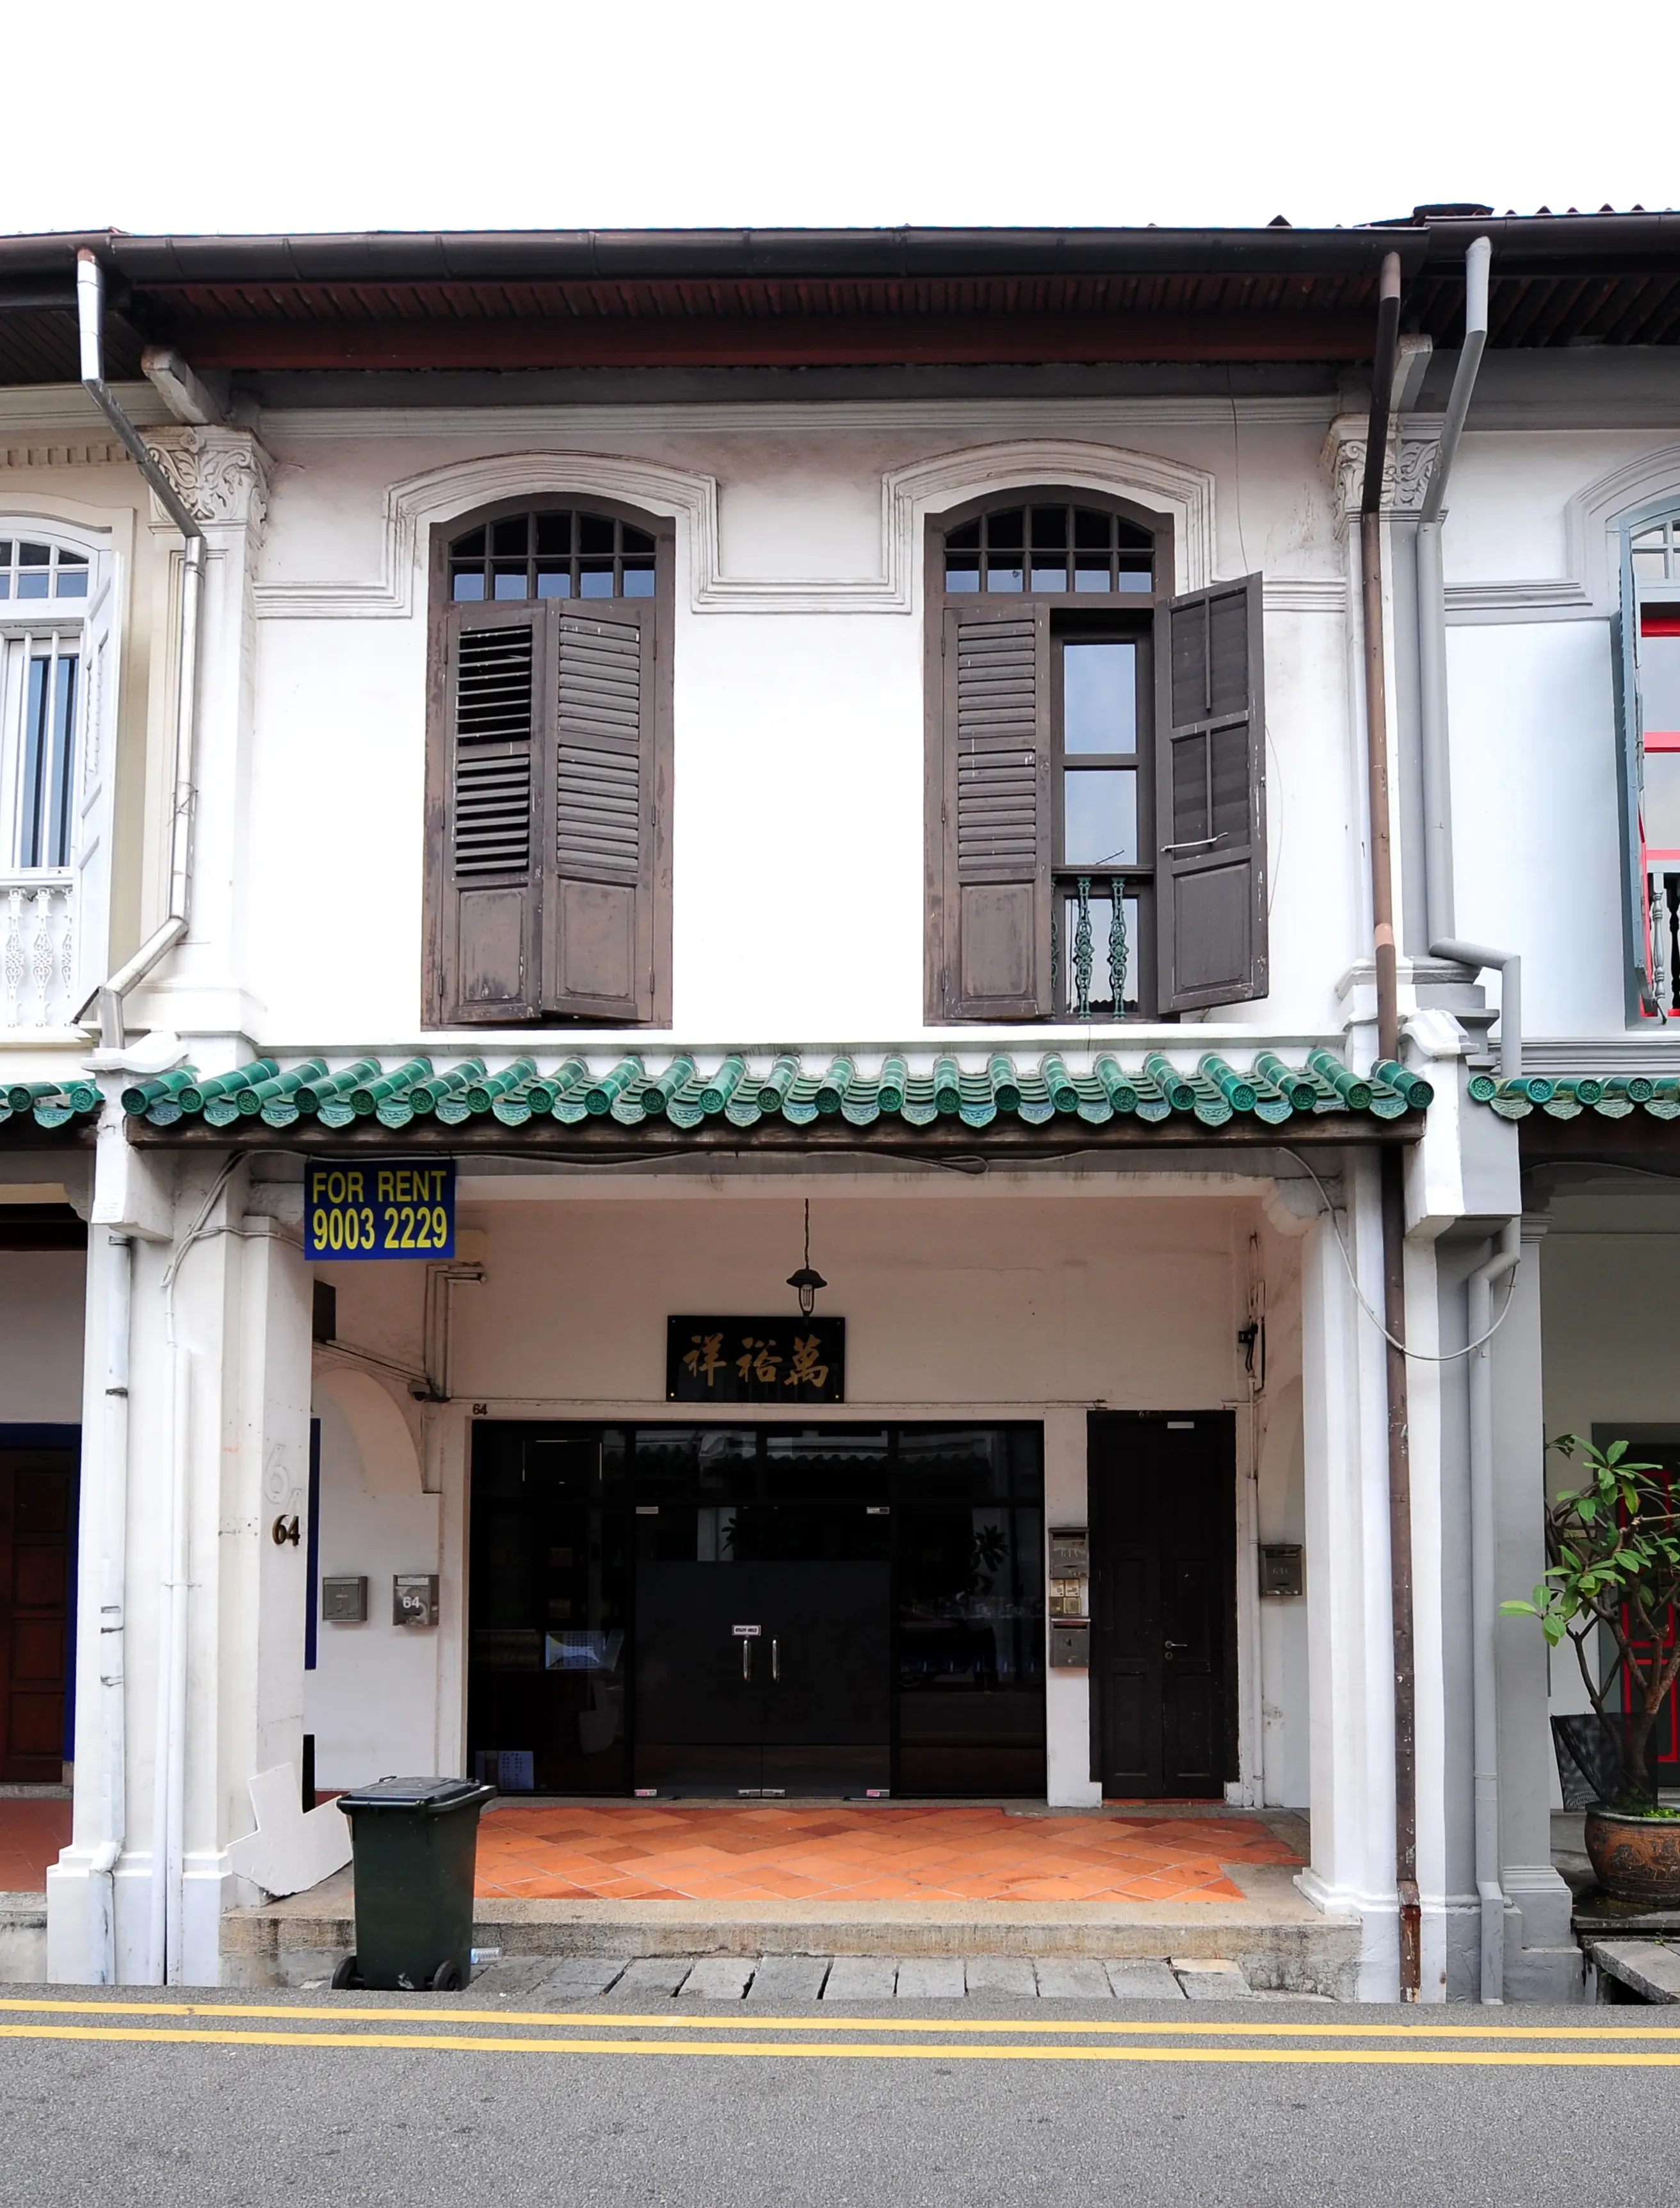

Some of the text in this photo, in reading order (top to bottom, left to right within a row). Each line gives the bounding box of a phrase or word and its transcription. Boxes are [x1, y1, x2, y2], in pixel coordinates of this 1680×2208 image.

[312, 1171, 447, 1203] FOR RENT
[312, 1206, 447, 1250] 9003 2229
[472, 1403, 489, 1415] 64
[272, 1514, 300, 1546] 64
[402, 1596, 421, 1609] 64
